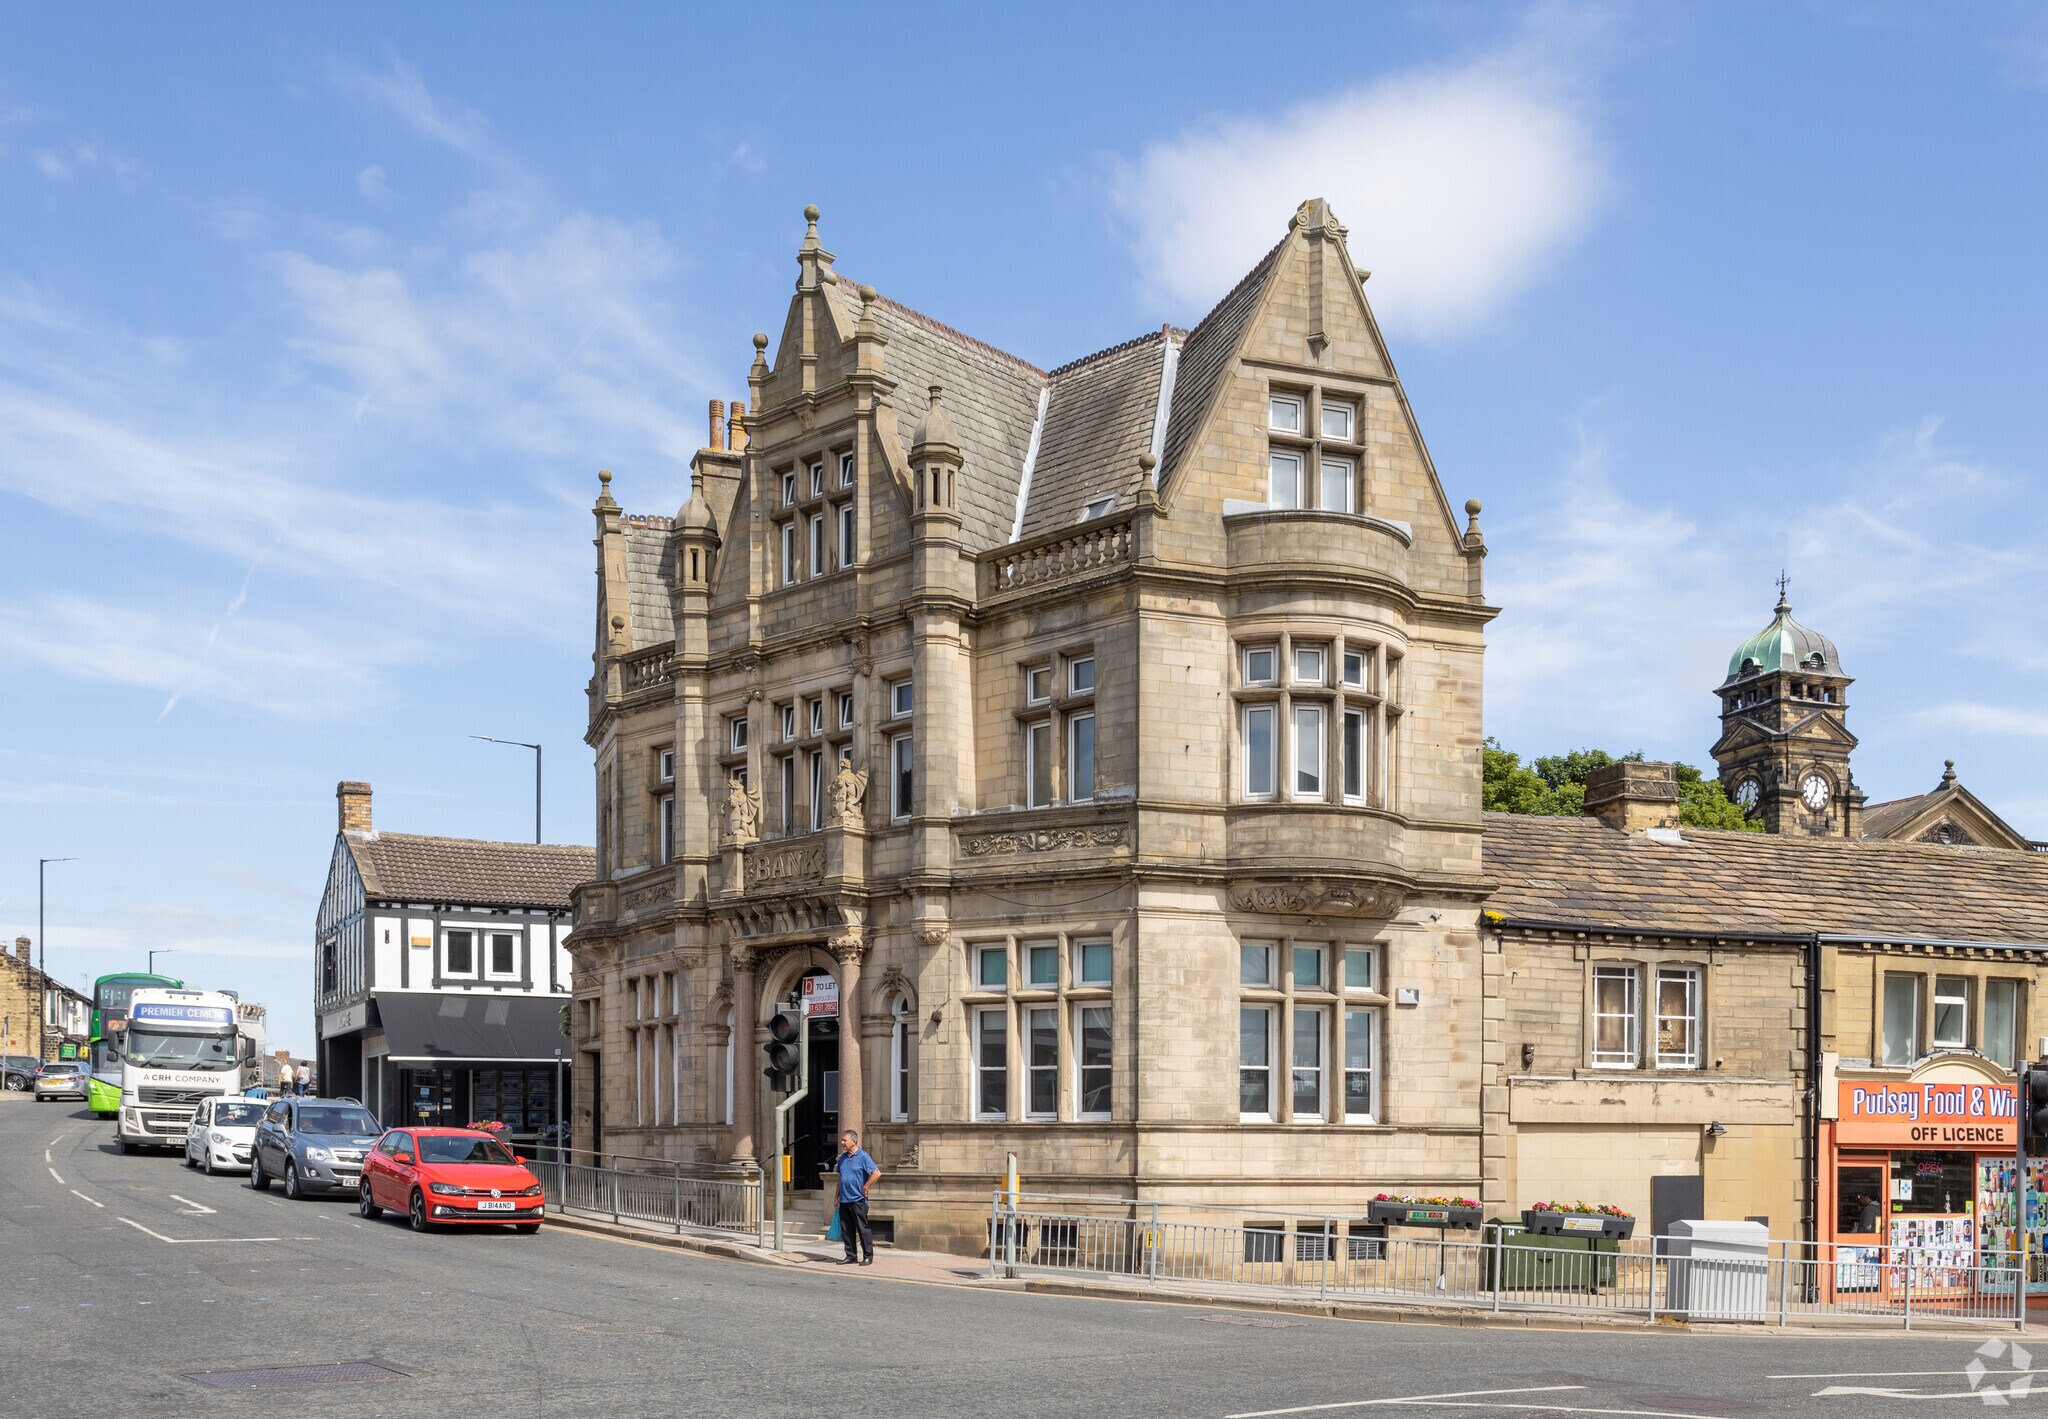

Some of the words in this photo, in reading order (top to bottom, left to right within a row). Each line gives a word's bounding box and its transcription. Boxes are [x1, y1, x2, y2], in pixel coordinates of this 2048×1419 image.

[756, 849, 820, 881] BANK
[816, 983, 824, 991] TO
[825, 982, 836, 990] LET
[141, 1006, 183, 1017] PREMIER
[152, 1074, 171, 1082] CRH
[175, 1075, 221, 1084] COMPANY
[1853, 1085, 1919, 1121] Pudsey
[1923, 1083, 1967, 1115] Food
[1970, 1086, 1985, 1117] &
[1911, 1127, 1938, 1141] OFF
[1943, 1127, 2004, 1142] LICENCE
[1918, 1162, 1943, 1173] OPEN
